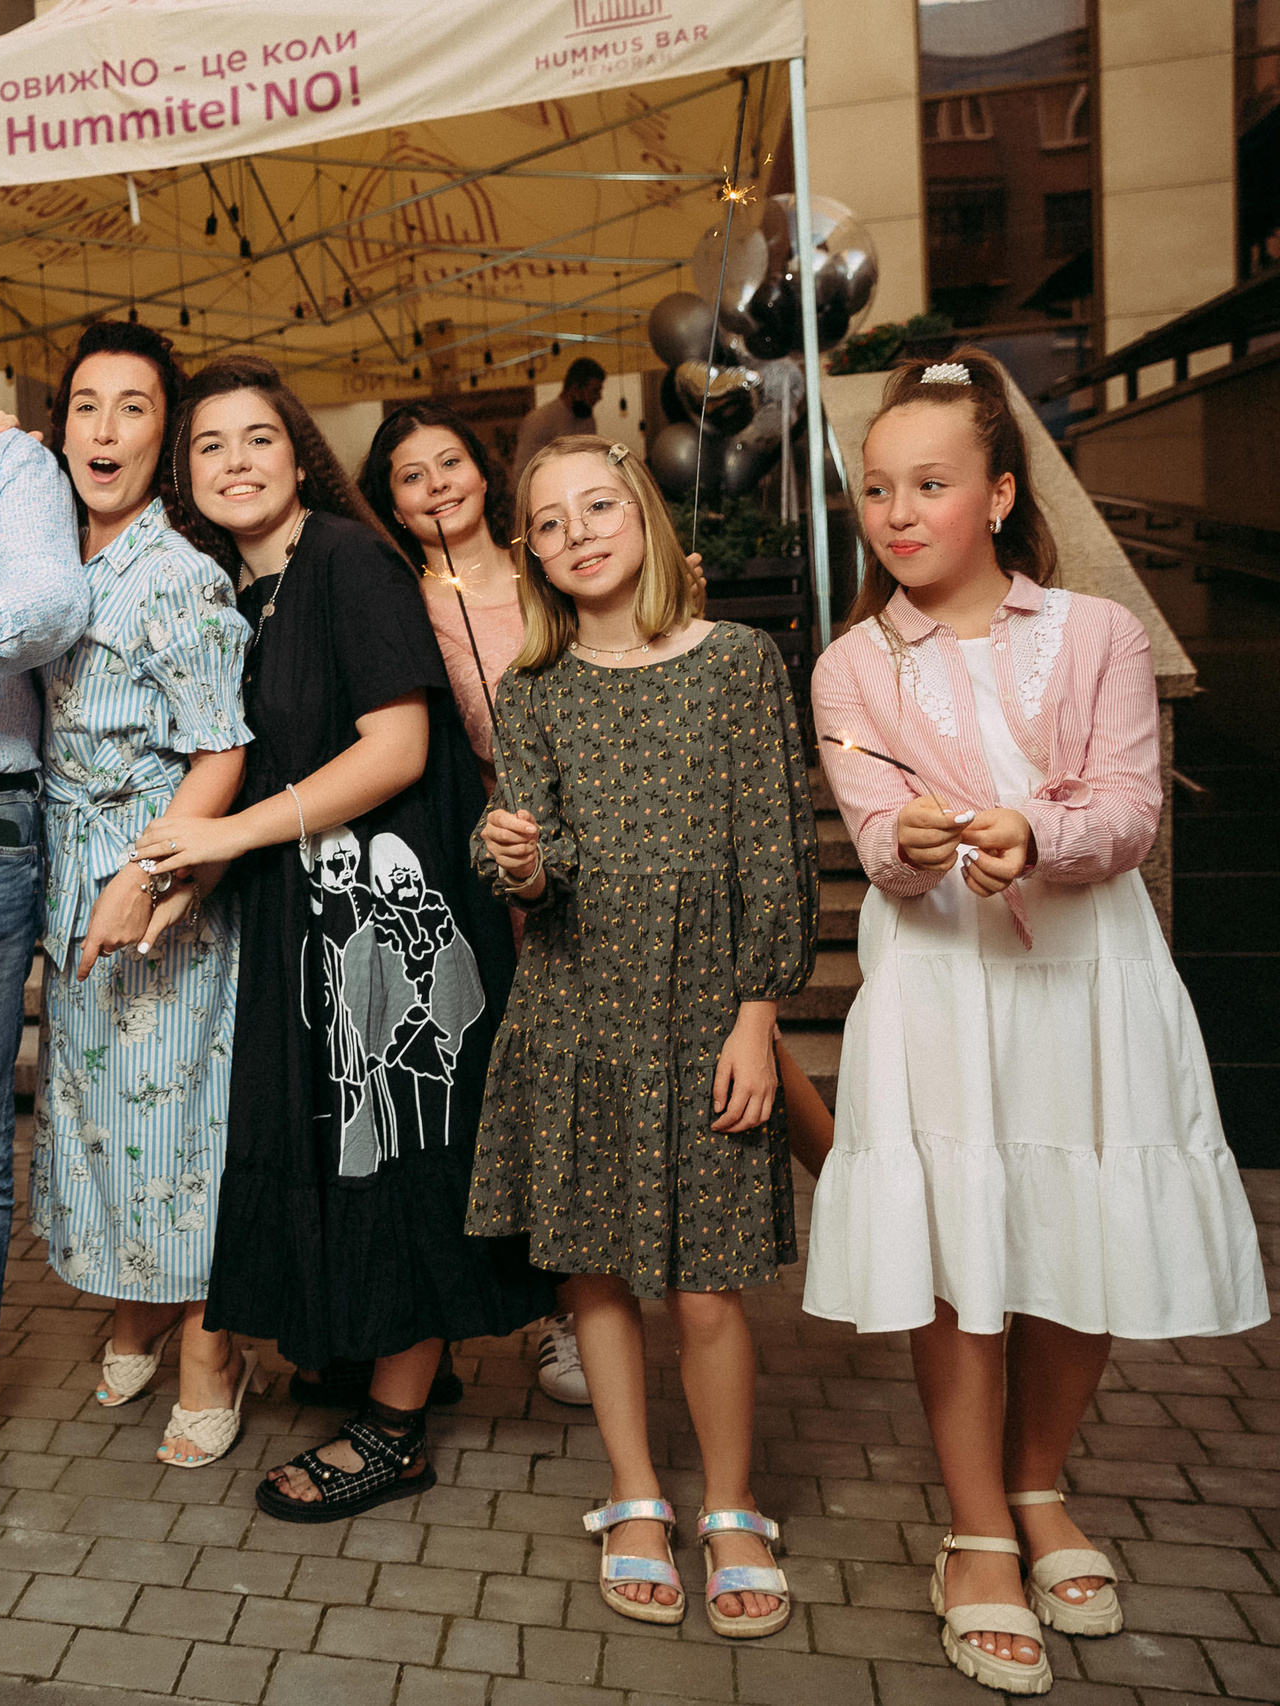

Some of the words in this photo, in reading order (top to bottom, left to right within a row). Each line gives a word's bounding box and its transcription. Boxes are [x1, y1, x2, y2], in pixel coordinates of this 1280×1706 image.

[201, 49, 248, 79] це
[262, 29, 357, 67] коли
[534, 36, 644, 71] HUMMUS
[655, 24, 709, 48] BAR
